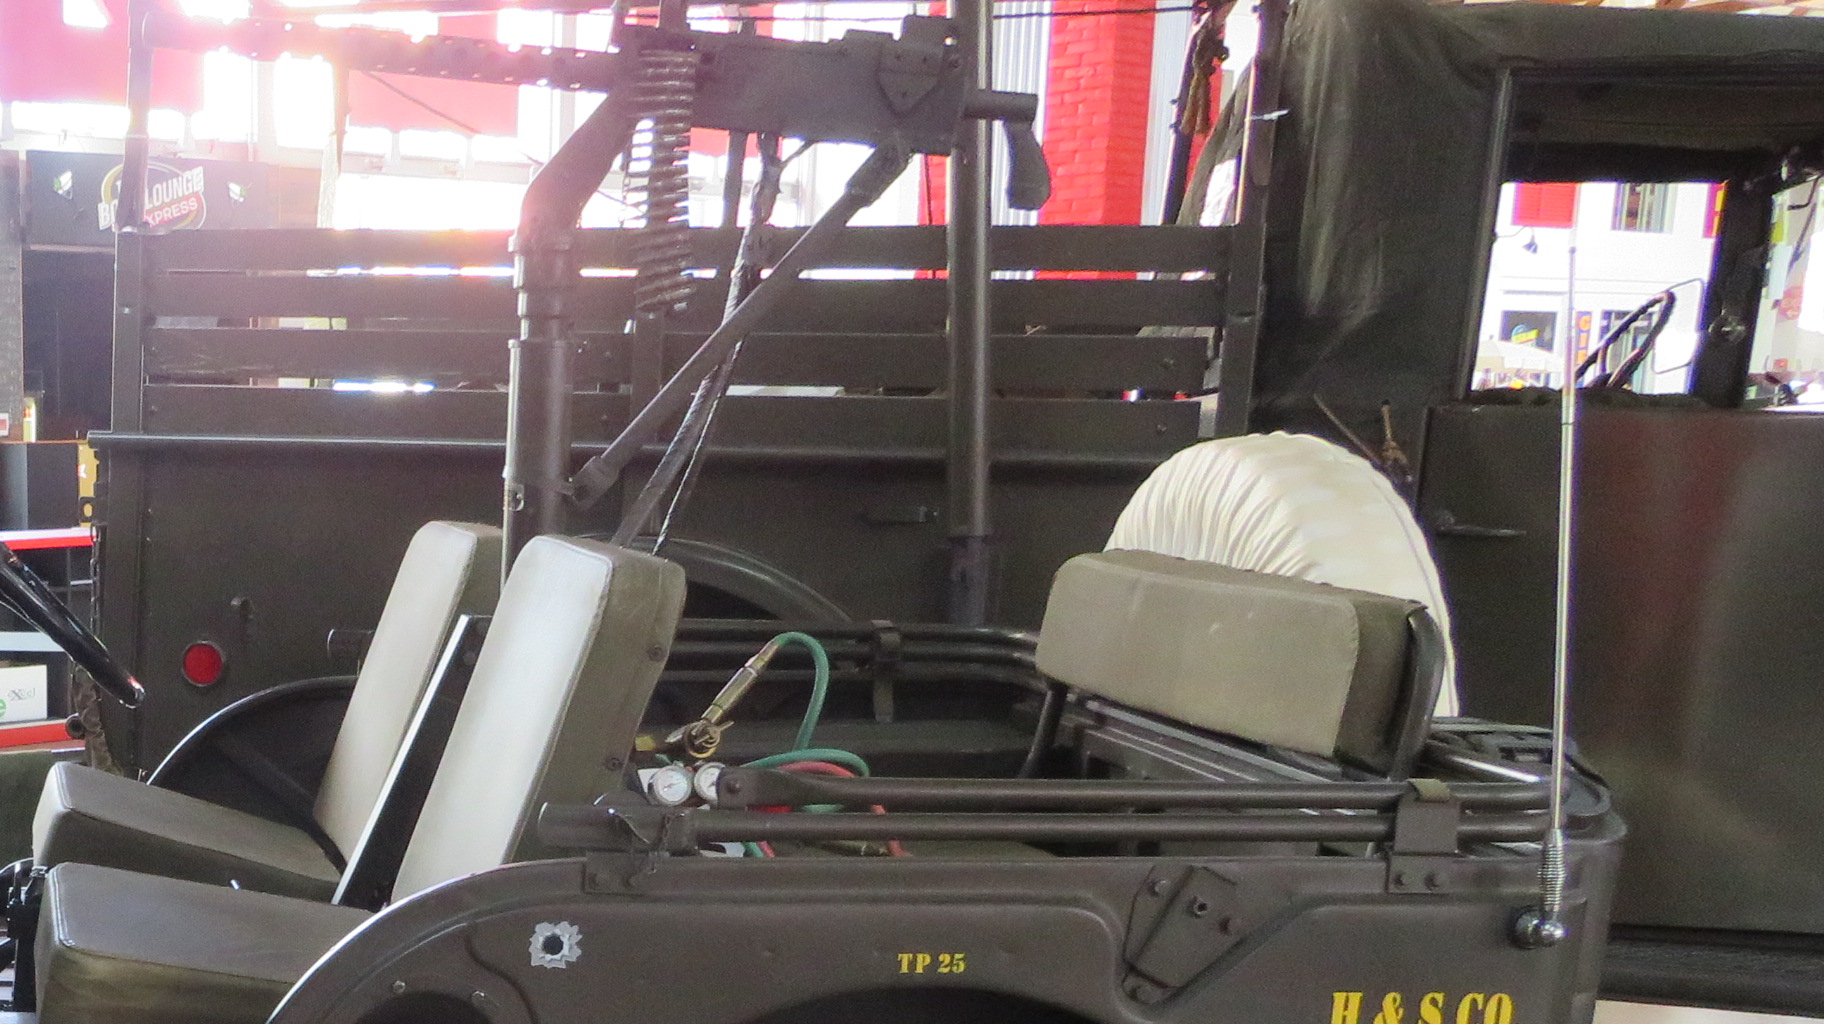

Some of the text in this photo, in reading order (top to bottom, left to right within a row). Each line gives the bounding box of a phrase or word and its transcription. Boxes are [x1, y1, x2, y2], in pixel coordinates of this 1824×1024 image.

[144, 166, 205, 210] LOUNGE
[144, 197, 198, 225] XPRESS
[897, 953, 966, 973] TP 25
